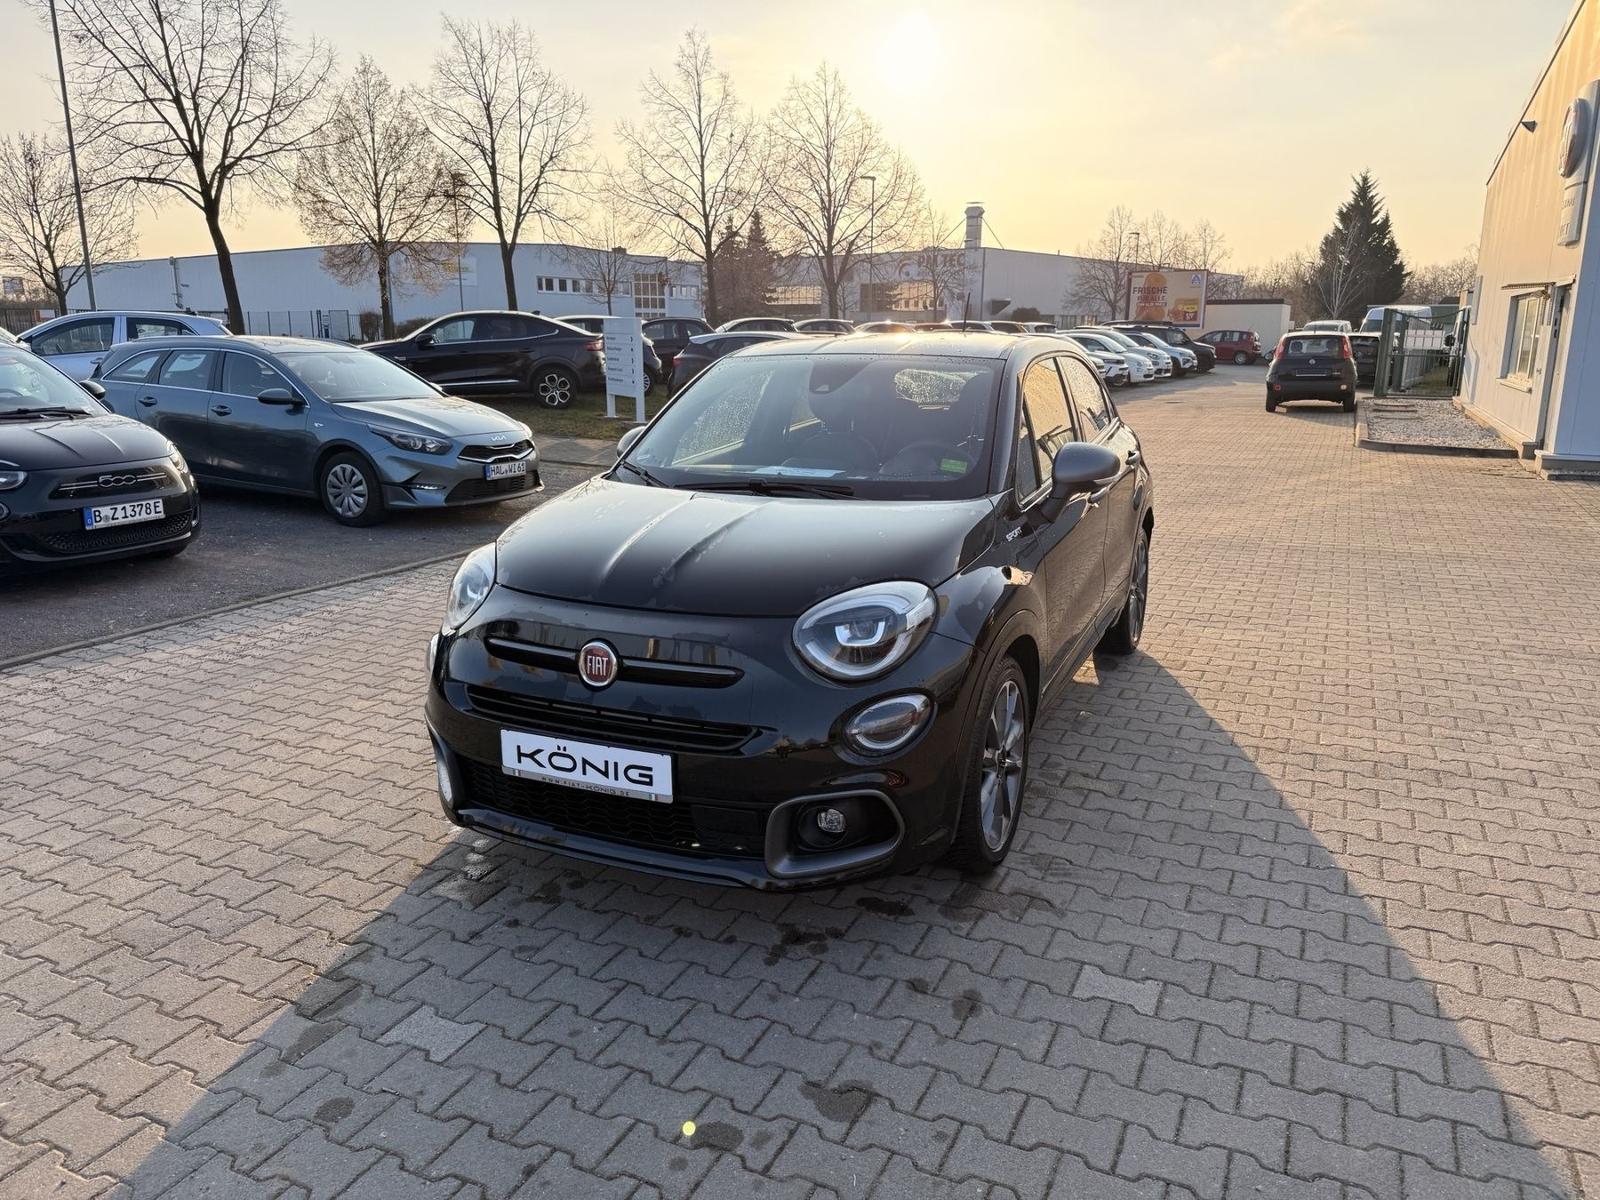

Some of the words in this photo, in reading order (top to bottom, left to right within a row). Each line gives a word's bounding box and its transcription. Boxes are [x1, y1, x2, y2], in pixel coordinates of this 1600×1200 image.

[1132, 286, 1168, 294] FRISCHE
[490, 464, 505, 476] HAL
[99, 474, 136, 488] 500
[93, 510, 102, 524] B
[587, 656, 609, 676] FIAT
[516, 744, 653, 787] KÖNIG
